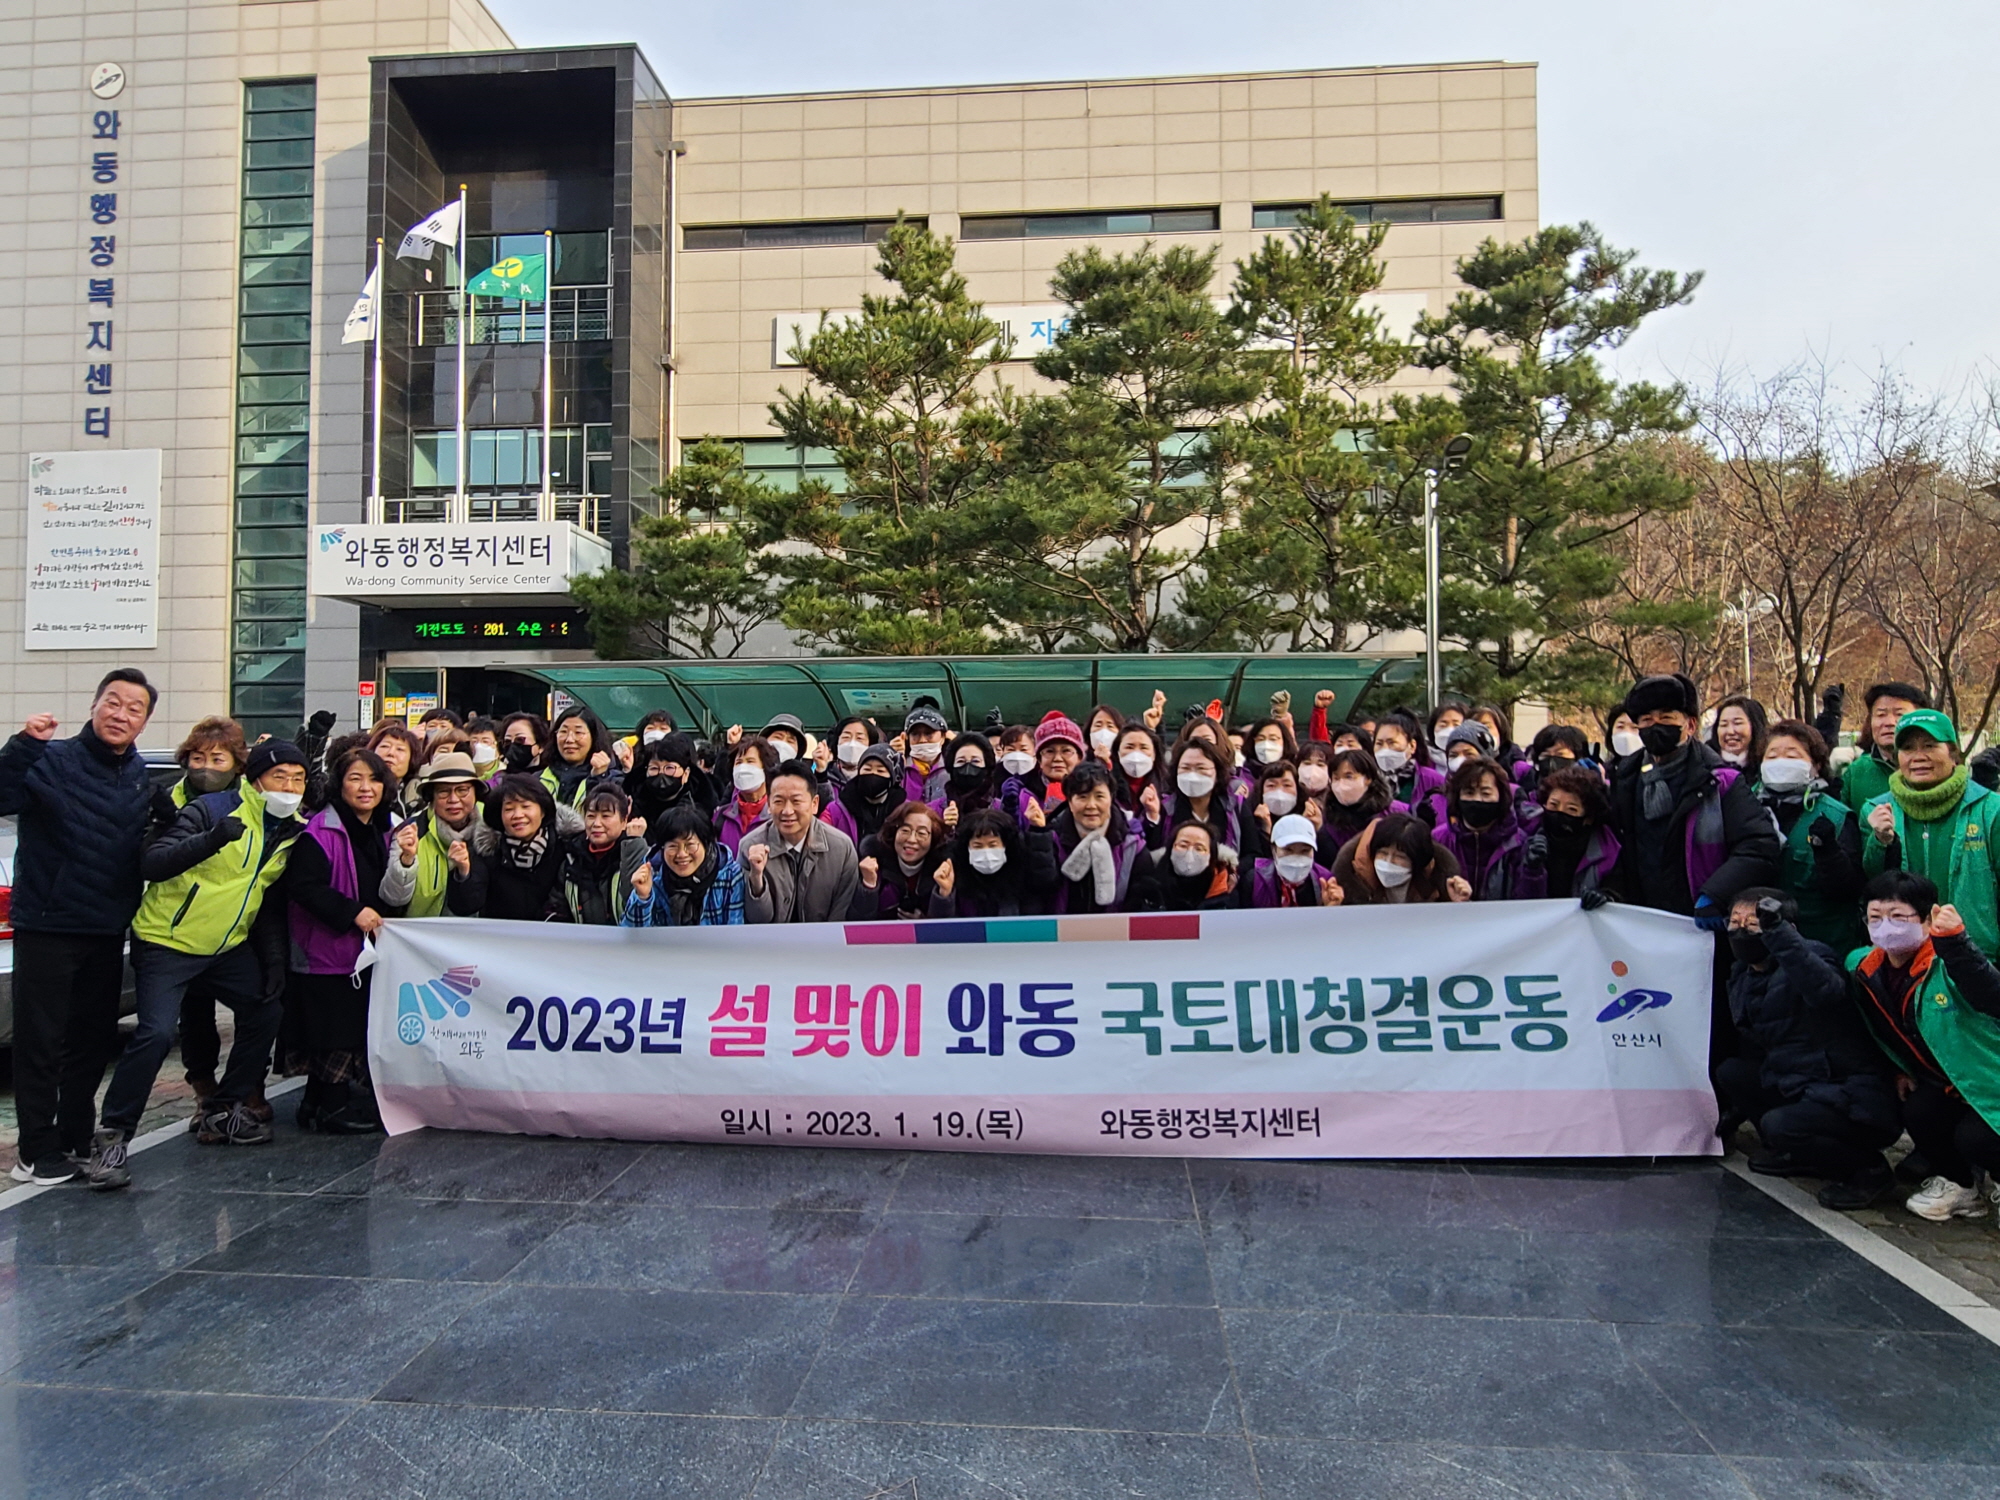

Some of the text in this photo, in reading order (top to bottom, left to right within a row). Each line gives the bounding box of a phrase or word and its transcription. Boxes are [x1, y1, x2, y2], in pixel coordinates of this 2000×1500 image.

[84, 110, 121, 438] 와동행정복지센터
[345, 535, 551, 567] 와동행정복지센터
[346, 574, 552, 588] Wa-dong Community Service Center
[415, 622, 466, 638] 기전도도
[484, 623, 510, 636] 201.
[516, 622, 542, 637] 수온
[506, 974, 1568, 1058] 2023년 설 맞이 와동 국토대청결운동
[1612, 1033, 1662, 1048] 안산시
[720, 1108, 771, 1137] 일시
[806, 1112, 880, 1136] 2023.
[894, 1111, 917, 1137] 1.
[1100, 1107, 1321, 1139] 와동행정복지센터
